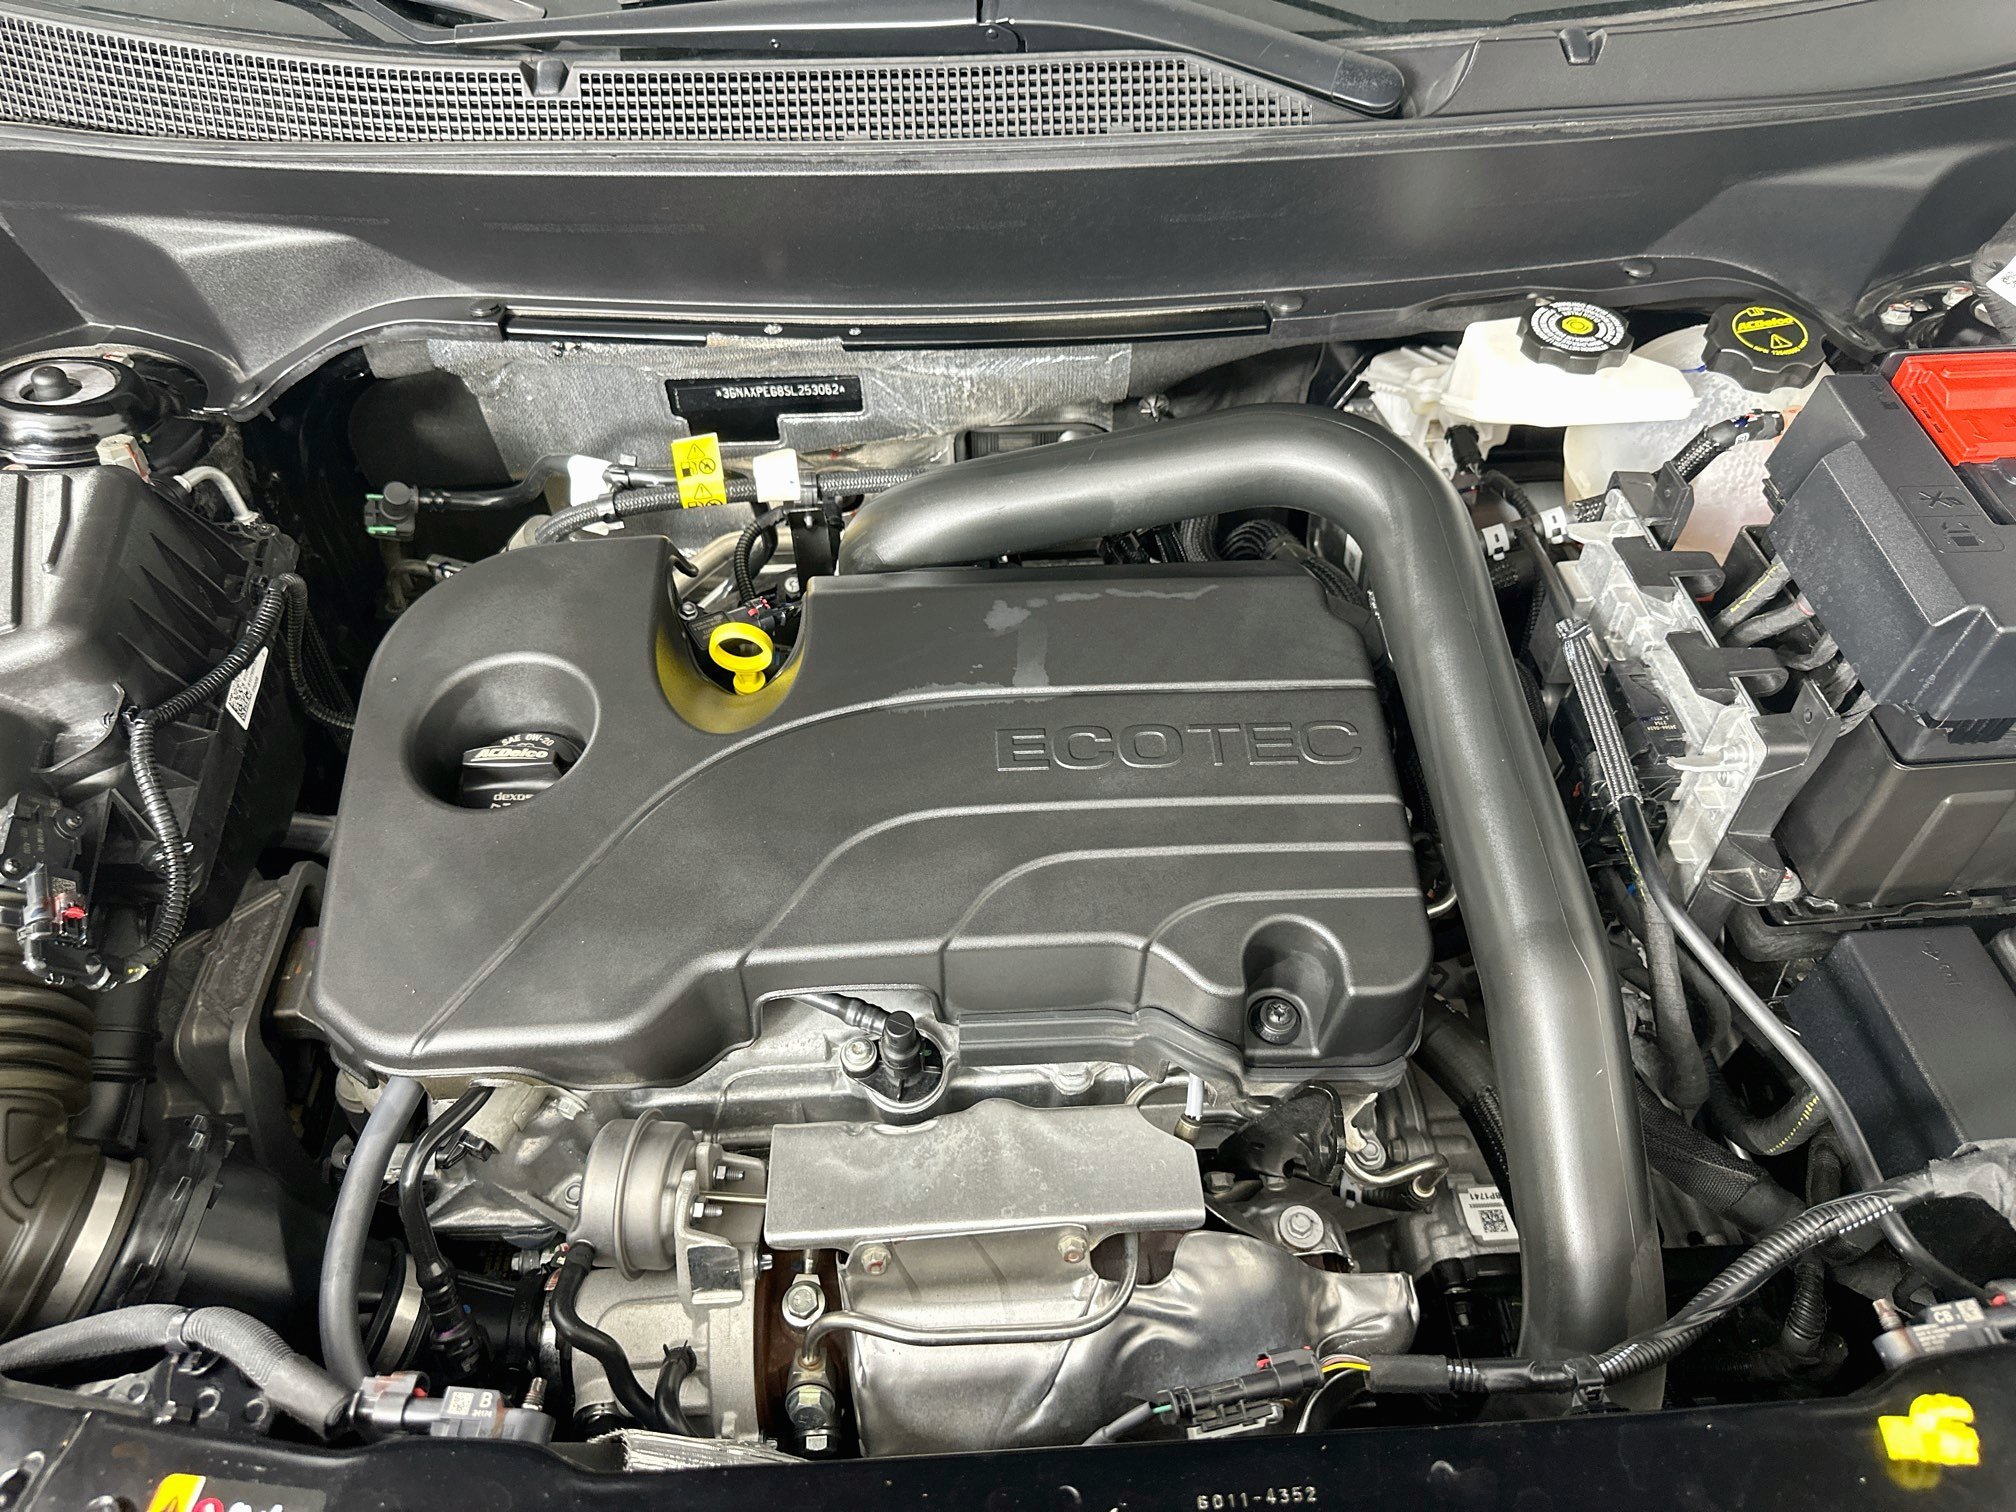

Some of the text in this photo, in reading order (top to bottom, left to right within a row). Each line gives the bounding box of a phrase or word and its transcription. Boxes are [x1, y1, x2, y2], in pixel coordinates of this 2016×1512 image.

[501, 733, 555, 747] SAE 0W-20
[995, 720, 1362, 772] ECOTEC
[474, 748, 549, 758] ACDelco
[479, 1391, 493, 1408] B
[1196, 1486, 1318, 1511] 6011-4352
